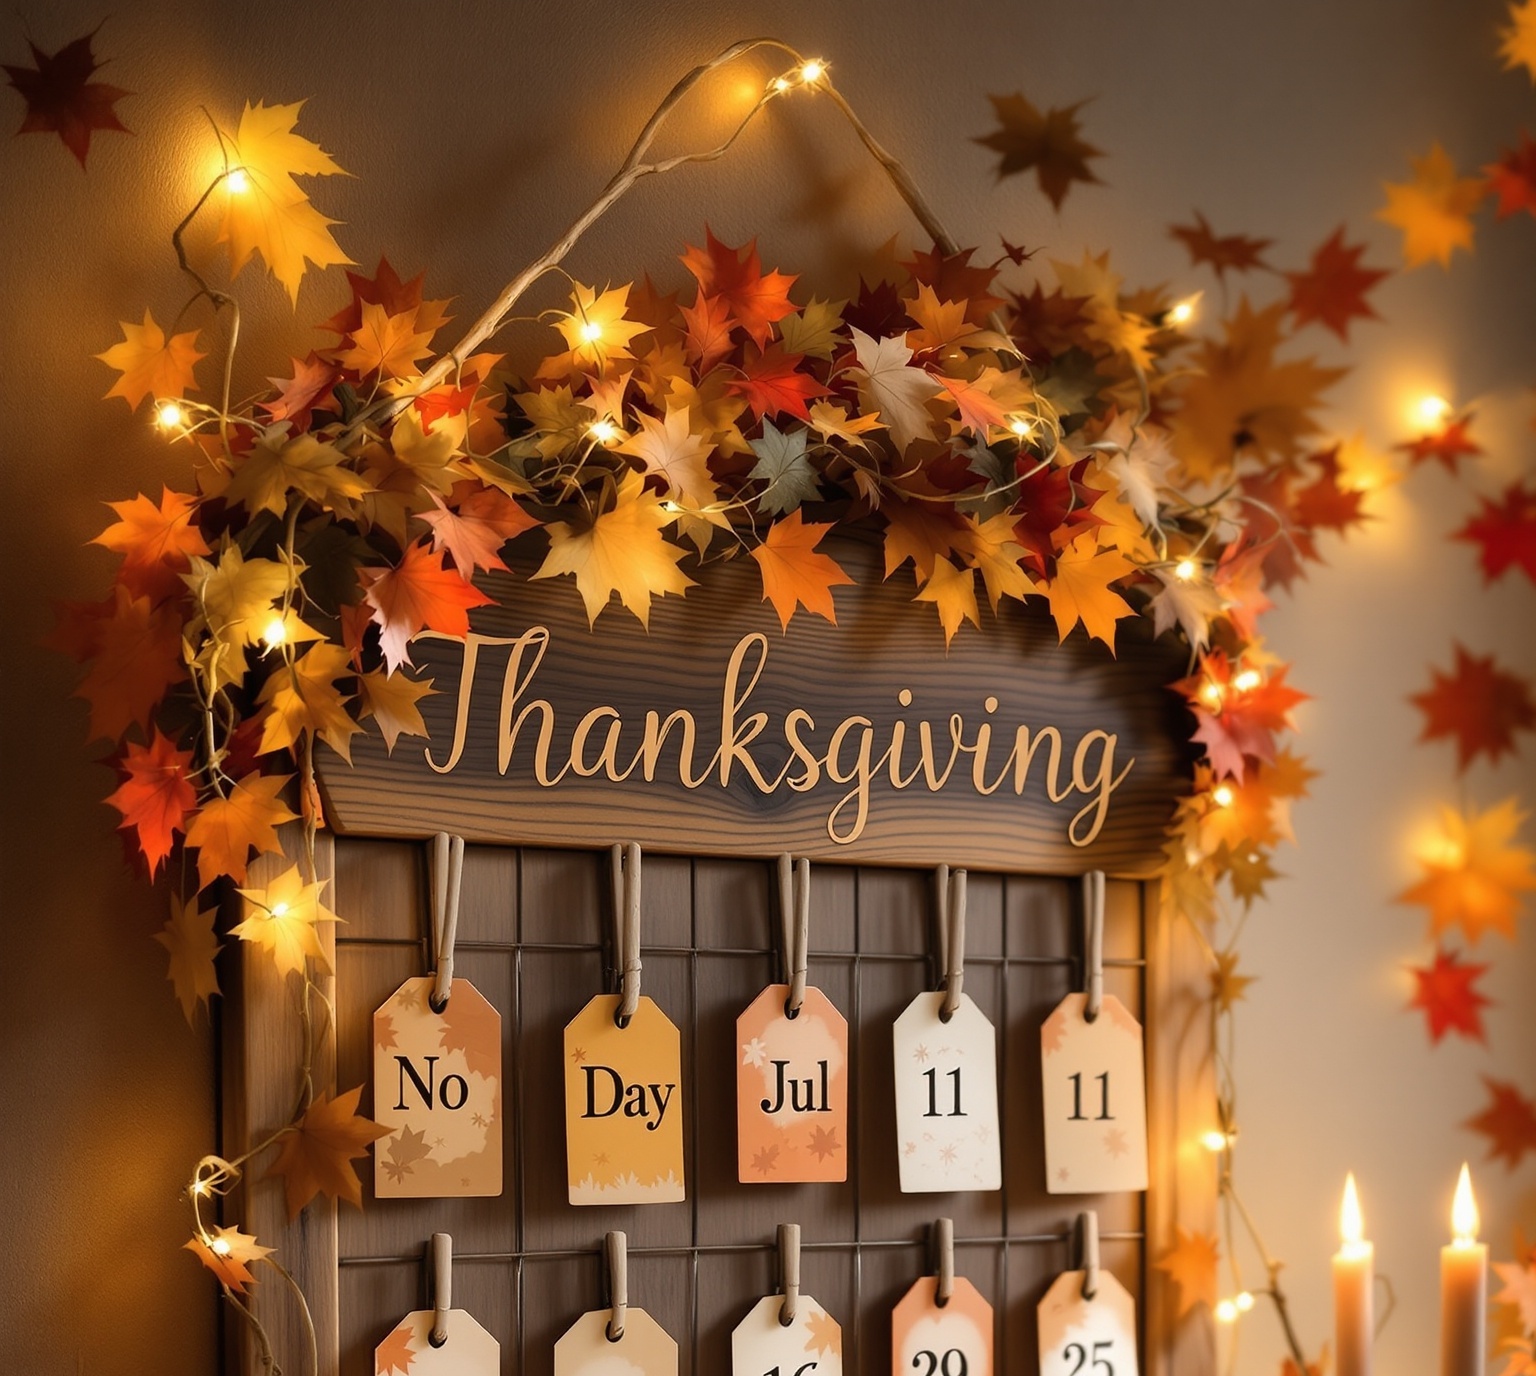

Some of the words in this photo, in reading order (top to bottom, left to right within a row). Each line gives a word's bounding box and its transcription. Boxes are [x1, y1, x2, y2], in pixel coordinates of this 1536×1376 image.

[412, 627, 1134, 847] Thanksgiving
[392, 1055, 469, 1111] No
[580, 1065, 676, 1131] Day
[760, 1060, 832, 1114] Jul
[922, 1067, 968, 1117] 11
[1067, 1072, 1114, 1121] 11
